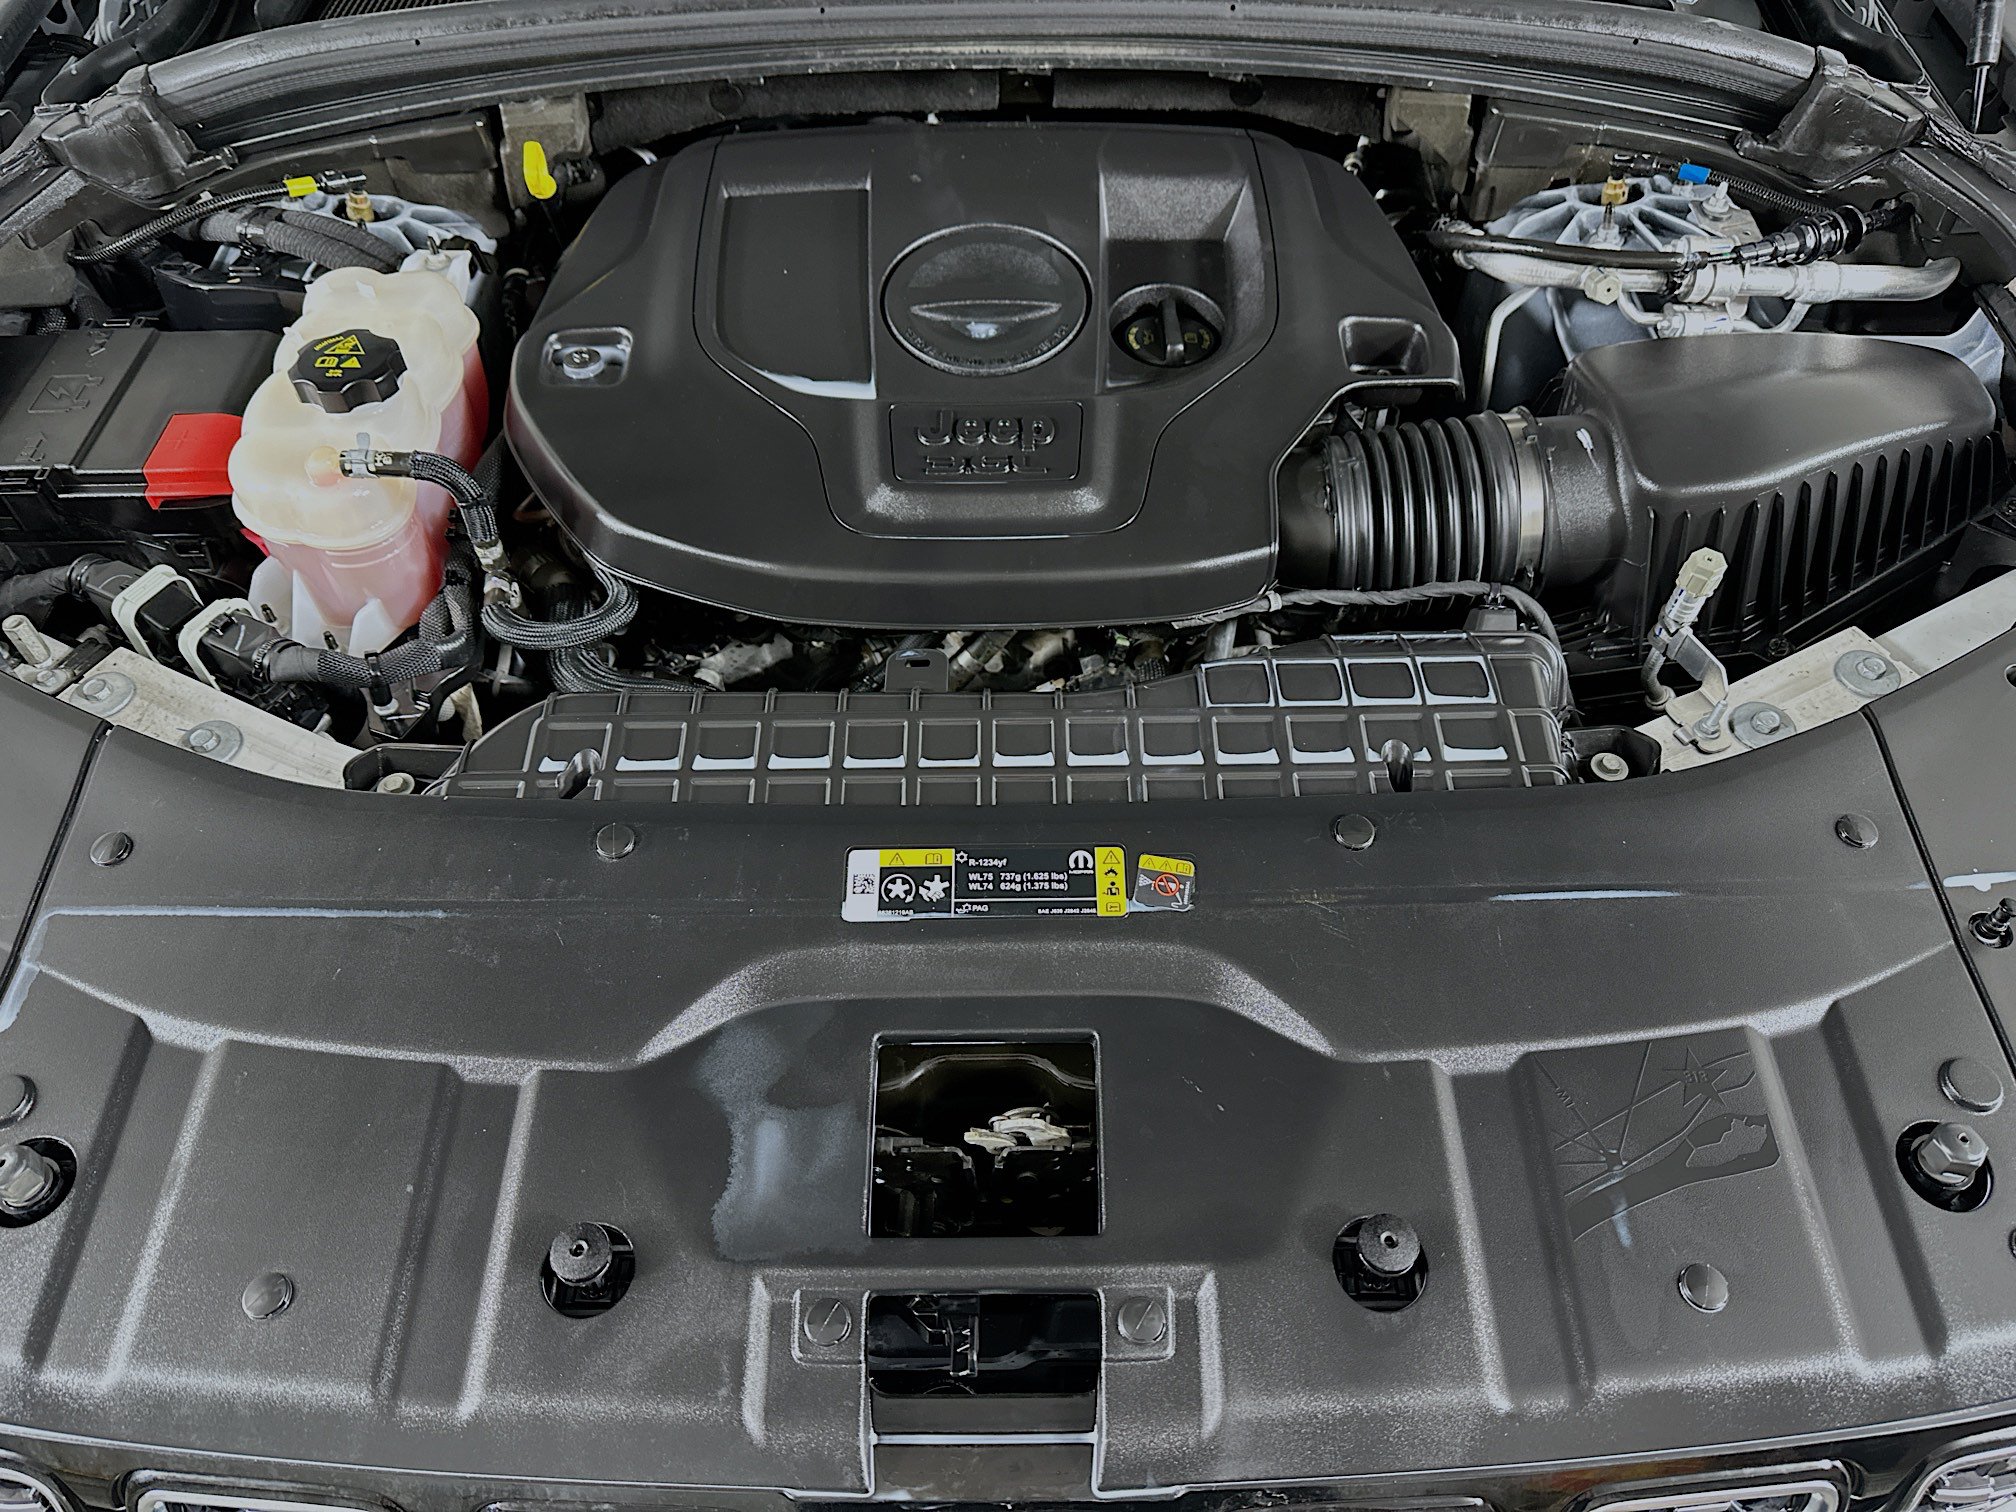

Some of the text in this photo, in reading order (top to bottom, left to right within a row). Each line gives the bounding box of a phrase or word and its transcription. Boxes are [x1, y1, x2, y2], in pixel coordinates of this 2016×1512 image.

[917, 408, 1055, 451] Jeep
[968, 858, 1008, 868] R-1234yf
[968, 872, 1068, 883] WL75 737g (1.625 lbs)
[968, 882, 1069, 892] WL74 624g (1.375 lbs)
[972, 904, 989, 912] PAG
